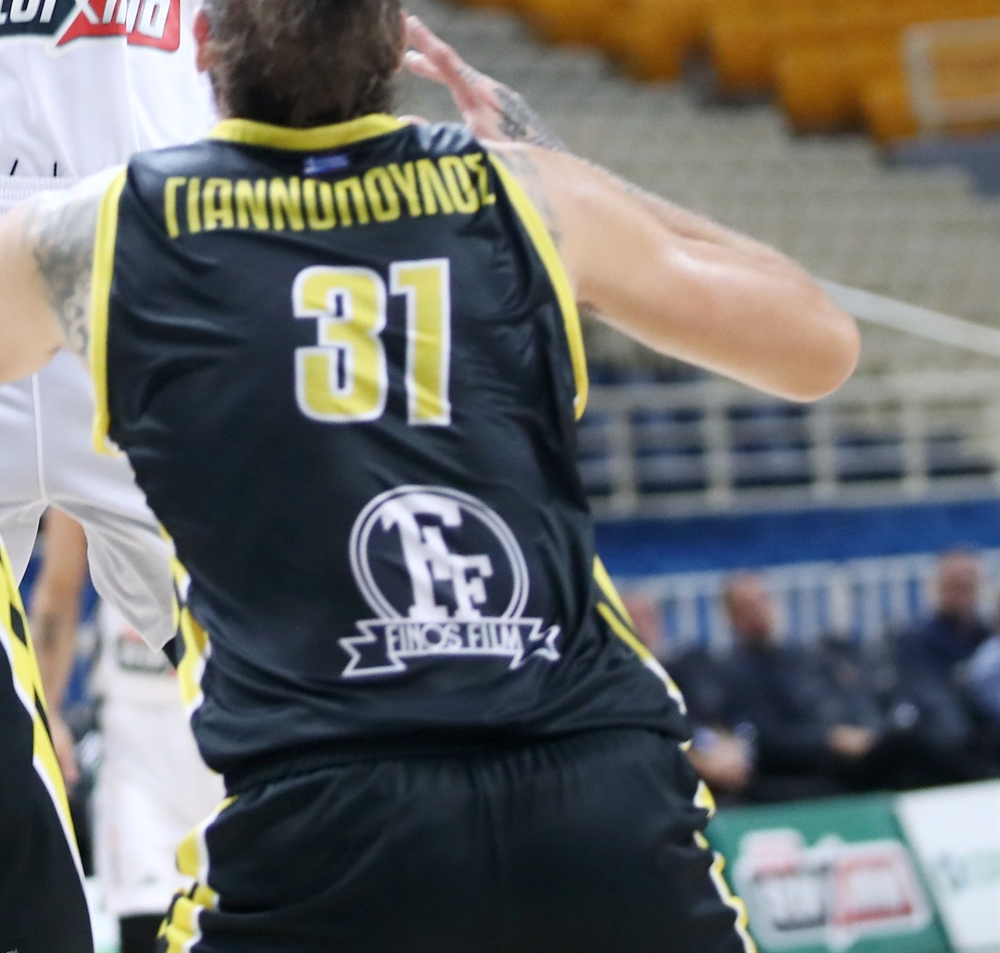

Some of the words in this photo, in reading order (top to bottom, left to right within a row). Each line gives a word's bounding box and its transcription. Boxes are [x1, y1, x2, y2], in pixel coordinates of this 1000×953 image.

[292, 258, 451, 426] 31
[386, 623, 462, 649] FINOS
[466, 623, 523, 649] FILM
